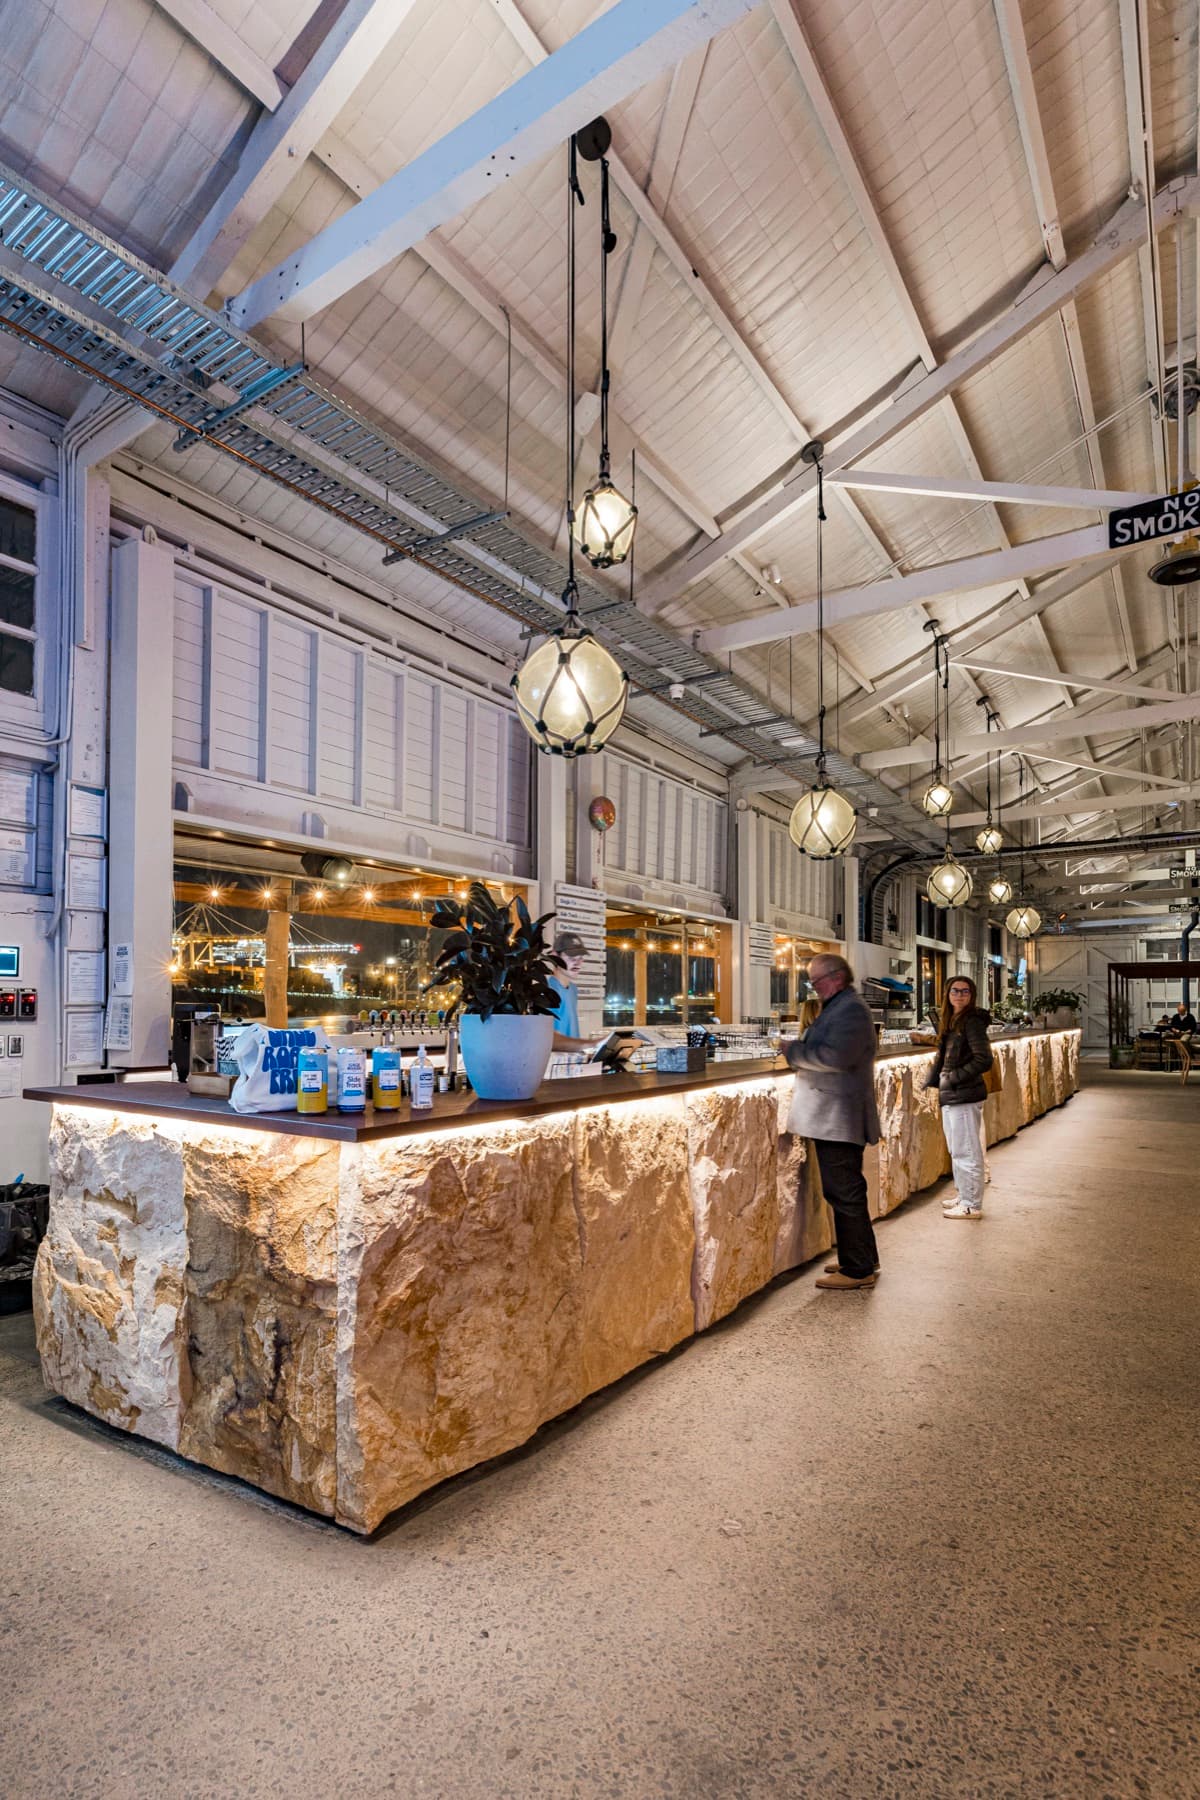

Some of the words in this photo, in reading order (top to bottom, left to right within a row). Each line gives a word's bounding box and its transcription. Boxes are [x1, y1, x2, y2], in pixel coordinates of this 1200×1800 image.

[1163, 492, 1200, 513] NO
[1114, 505, 1200, 544] SMOK
[1170, 870, 1199, 878] SMOKI
[262, 1046, 298, 1072] ROA
